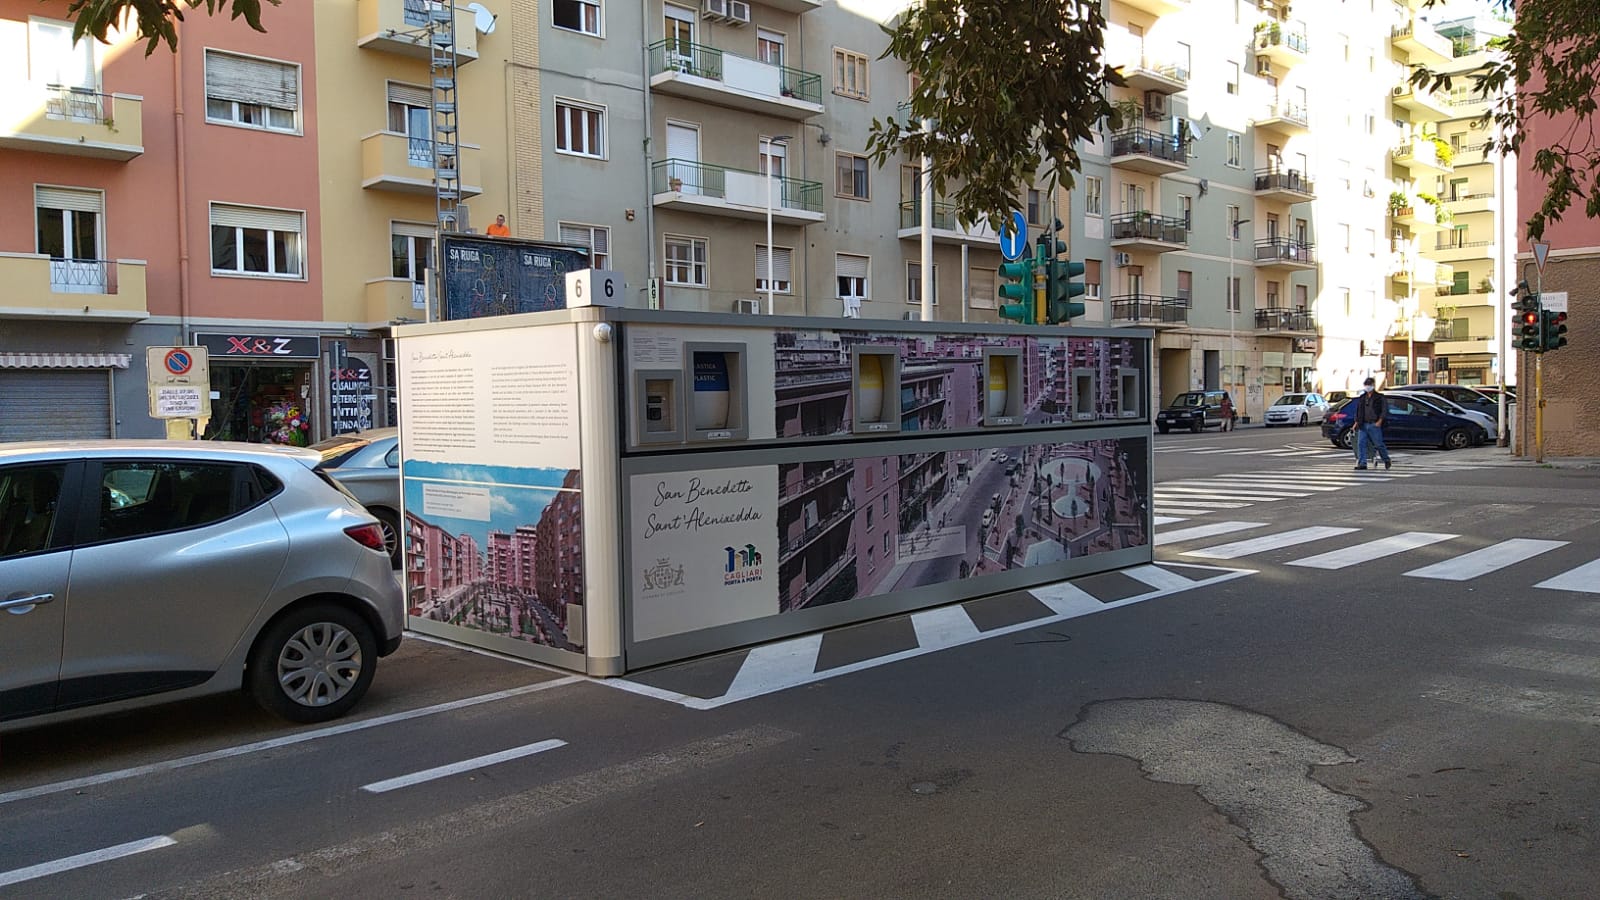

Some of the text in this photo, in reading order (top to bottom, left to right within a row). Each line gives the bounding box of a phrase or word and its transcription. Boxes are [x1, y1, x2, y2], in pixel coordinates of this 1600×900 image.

[449, 248, 480, 261] SA RUGA
[523, 254, 552, 267] SA RUGA
[575, 279, 583, 298] 6
[604, 278, 614, 298] 6
[226, 336, 293, 354] X&Z
[654, 477, 753, 507] San Benedetto
[644, 507, 762, 539] Sant'Alenixedda
[724, 568, 763, 581] CAGLIARI
